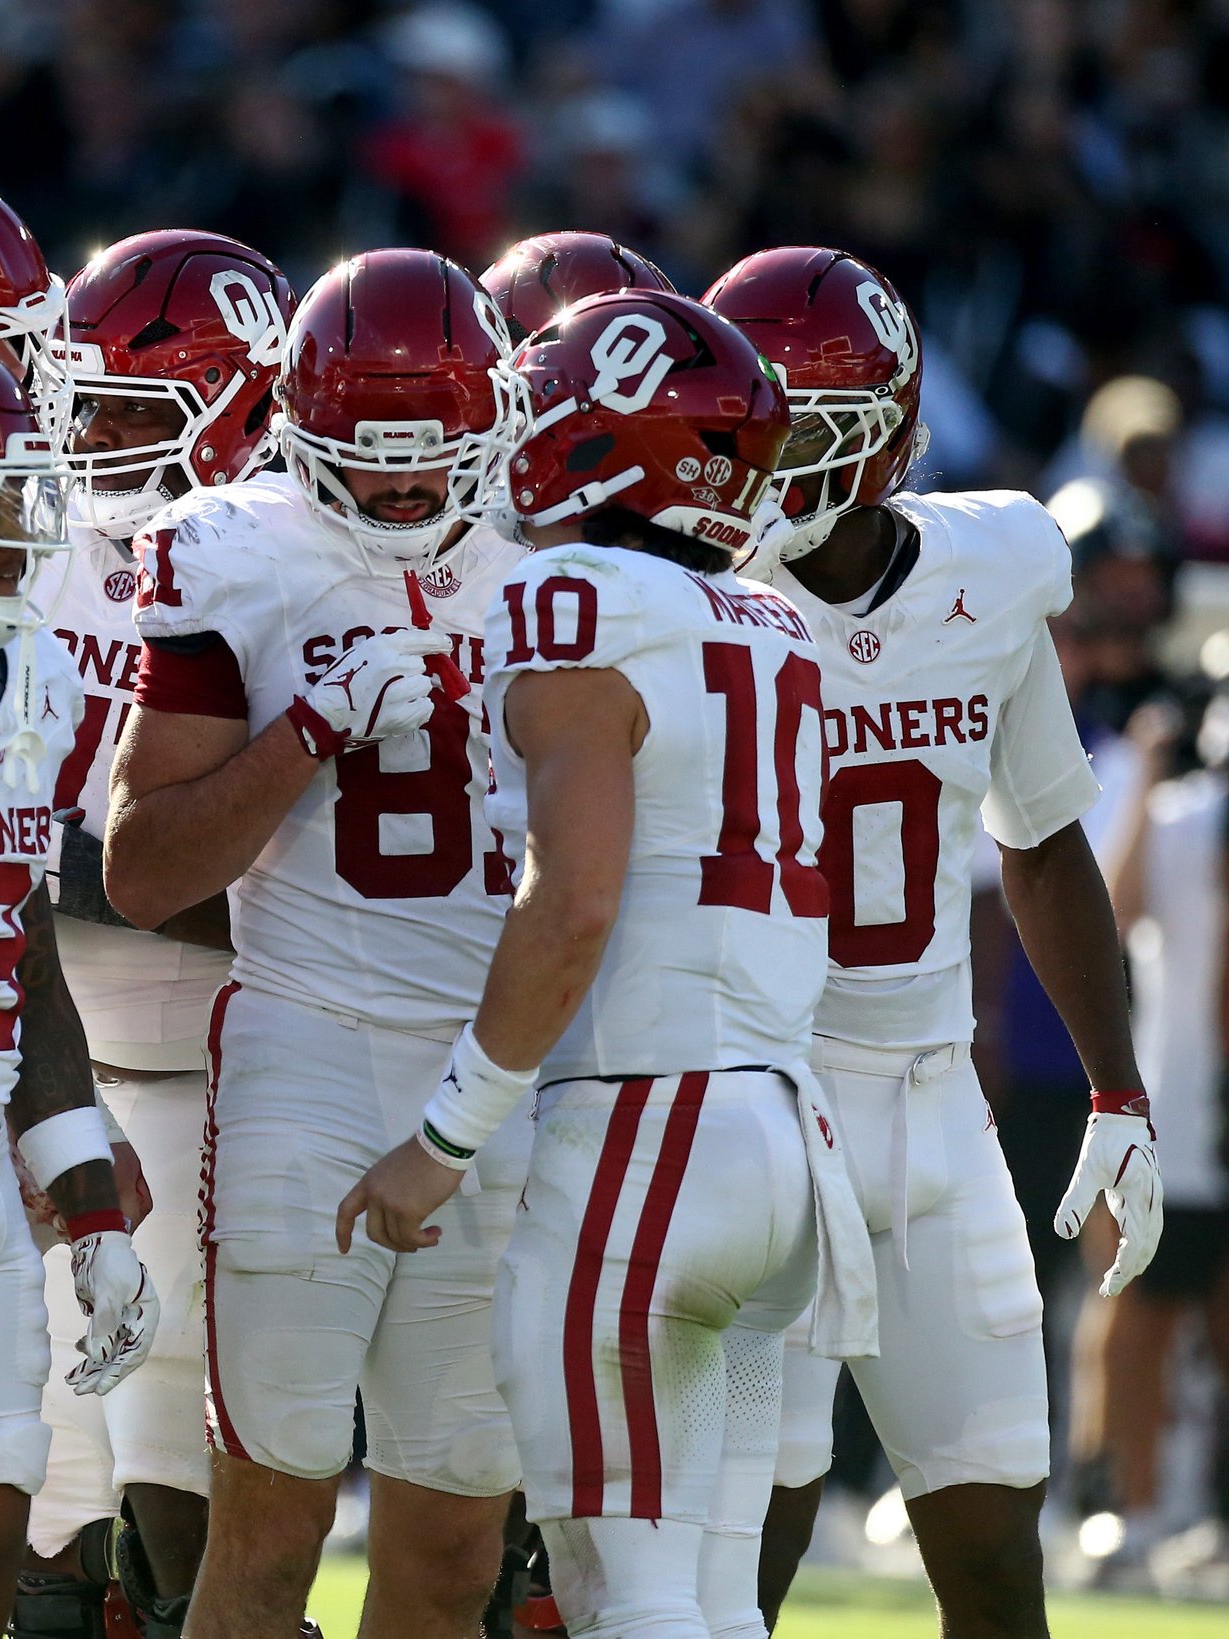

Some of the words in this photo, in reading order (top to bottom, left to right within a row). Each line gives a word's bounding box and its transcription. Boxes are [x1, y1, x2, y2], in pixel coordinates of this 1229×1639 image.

[209, 269, 287, 367] OU
[589, 313, 675, 416] OU
[678, 460, 699, 478] SH
[706, 457, 732, 486] SEC
[106, 572, 136, 602] SEC
[503, 575, 598, 667] 10
[850, 631, 881, 662] SEC
[697, 641, 830, 919] 10
[827, 758, 943, 969] 0
